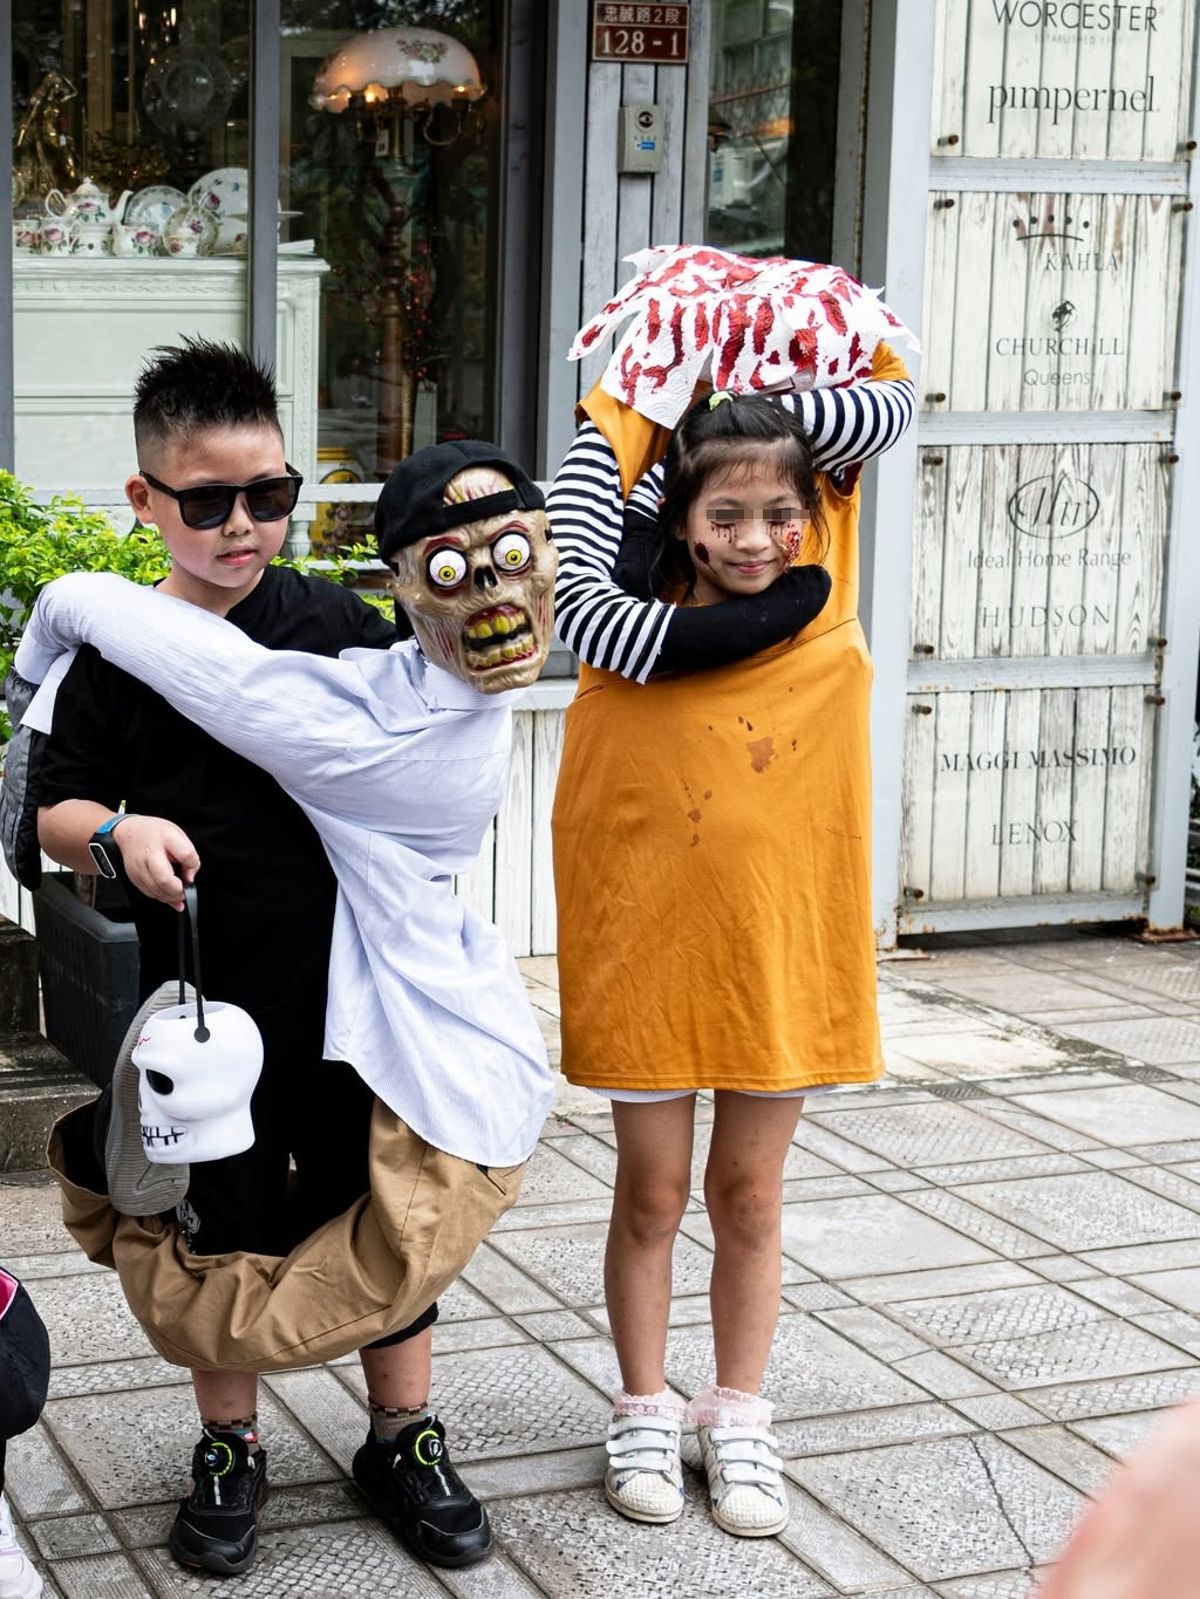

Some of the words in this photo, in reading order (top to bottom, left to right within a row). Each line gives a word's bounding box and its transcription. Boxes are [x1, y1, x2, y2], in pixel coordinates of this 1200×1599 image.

[604, 6, 680, 24] 忠誠路2段
[992, 0, 1158, 32] WORCESTER
[1023, 369, 1092, 386] Queens
[968, 549, 1010, 569] Ideal
[1019, 549, 1071, 568] Home
[1078, 548, 1132, 572] Range
[982, 604, 1111, 629] HUDSON
[940, 750, 1019, 772] MAGGI
[1028, 745, 1136, 769] MASSIMO
[991, 818, 1078, 846] LENOX
